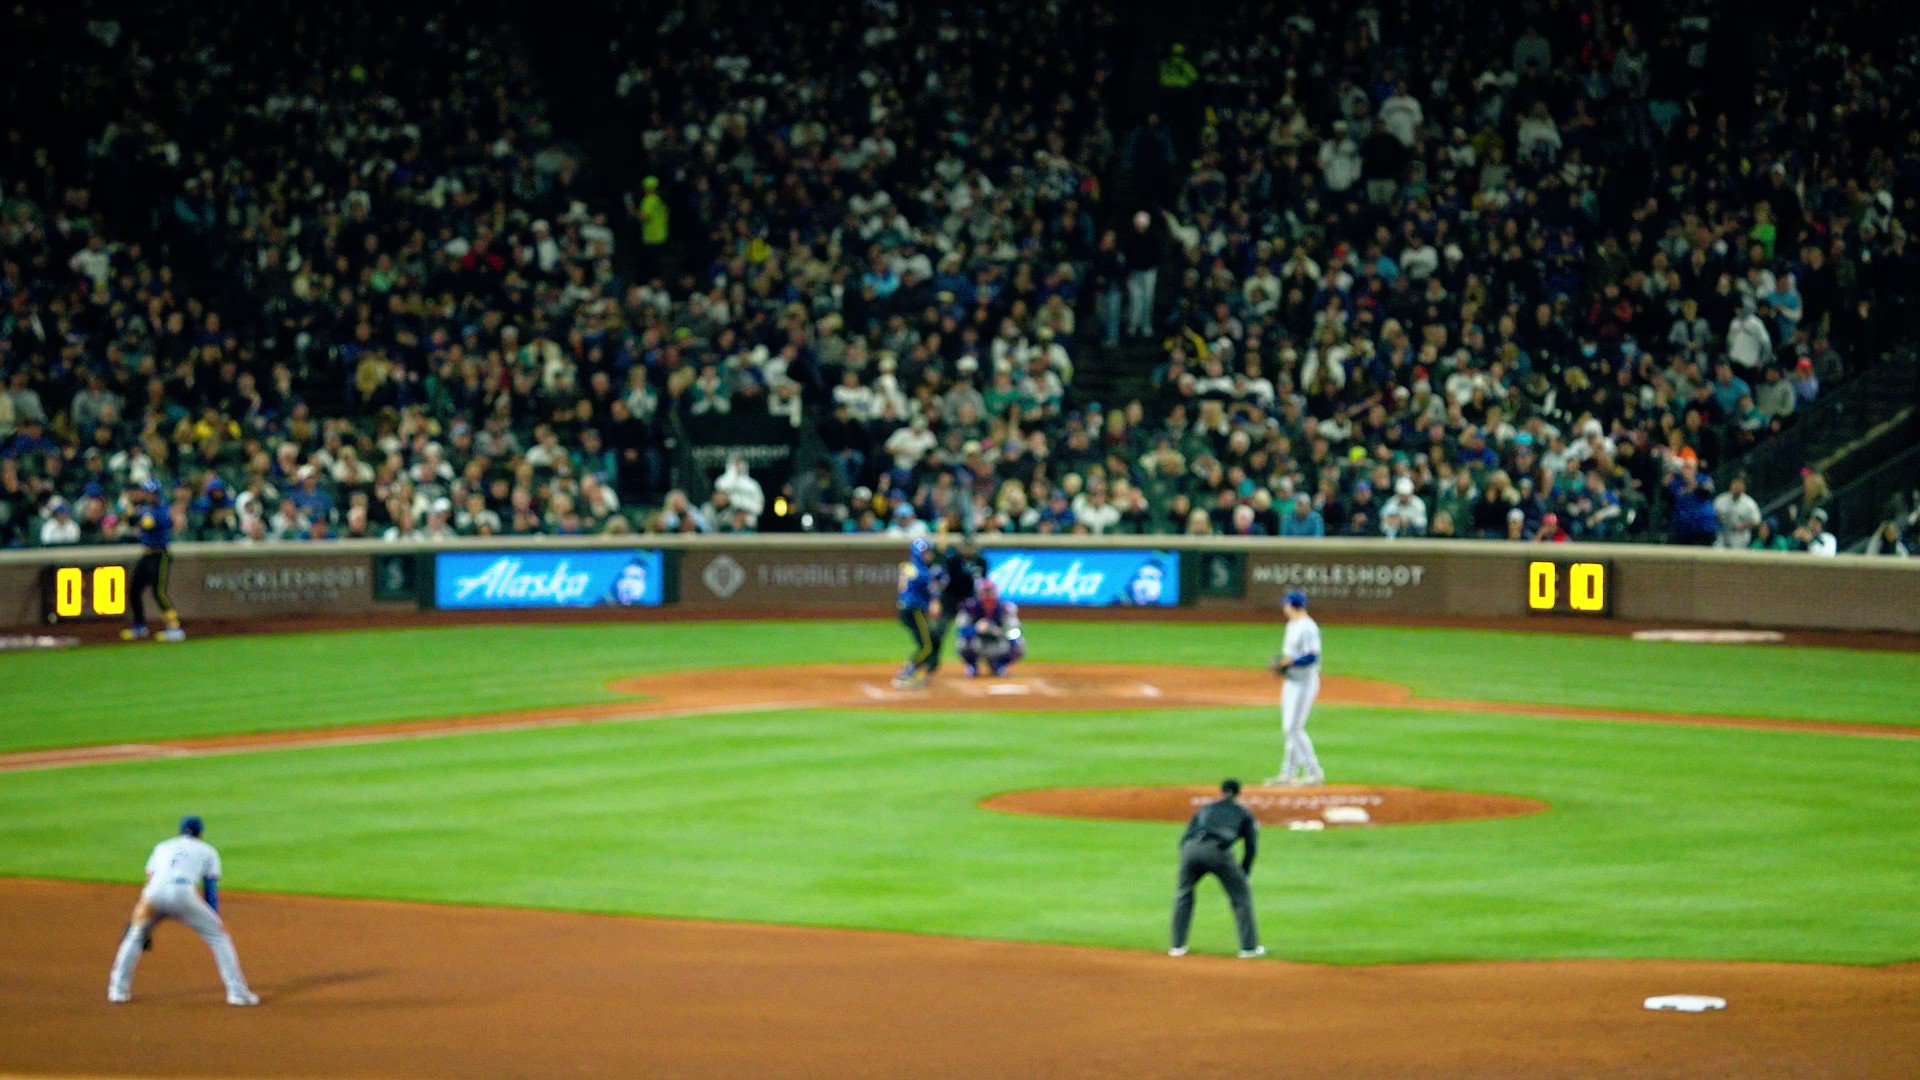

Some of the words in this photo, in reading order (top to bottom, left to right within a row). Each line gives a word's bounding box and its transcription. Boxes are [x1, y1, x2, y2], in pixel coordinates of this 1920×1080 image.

[57, 567, 82, 617] 0
[456, 557, 590, 603] Alaska
[988, 556, 1103, 601] Alaska
[1253, 565, 1425, 586] MUCKLESHOOT
[1529, 561, 1556, 609] 0
